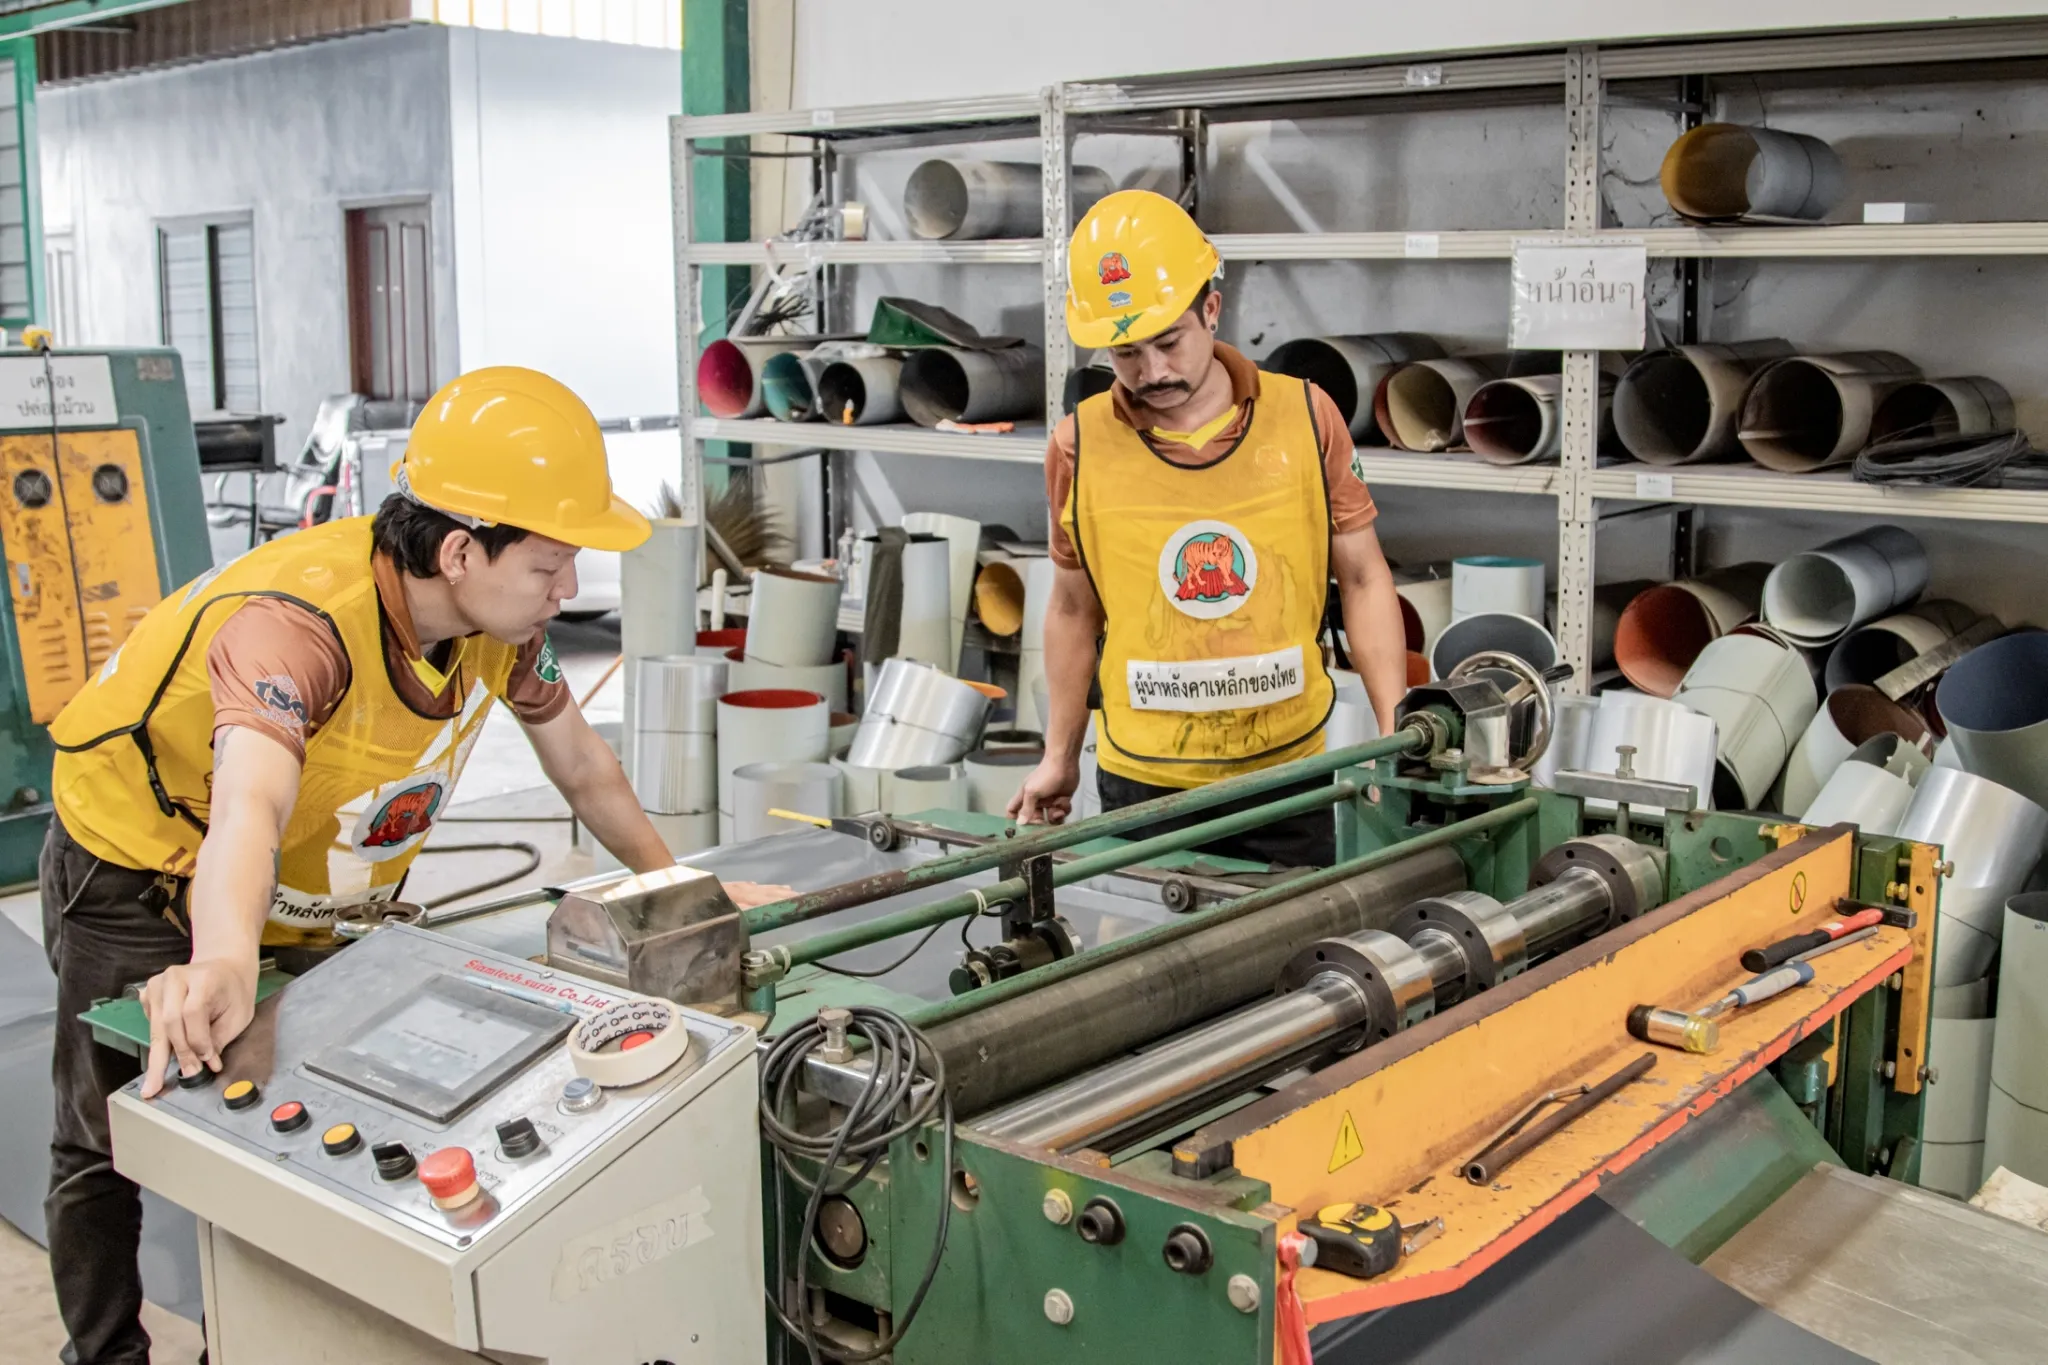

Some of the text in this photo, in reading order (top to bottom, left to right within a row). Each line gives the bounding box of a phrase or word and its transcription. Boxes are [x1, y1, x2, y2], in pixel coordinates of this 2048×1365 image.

[1526, 260, 1635, 309] หน้าอื่นๆ
[1134, 663, 1296, 705] ผู้นำหลังคาเหล็กของไทย
